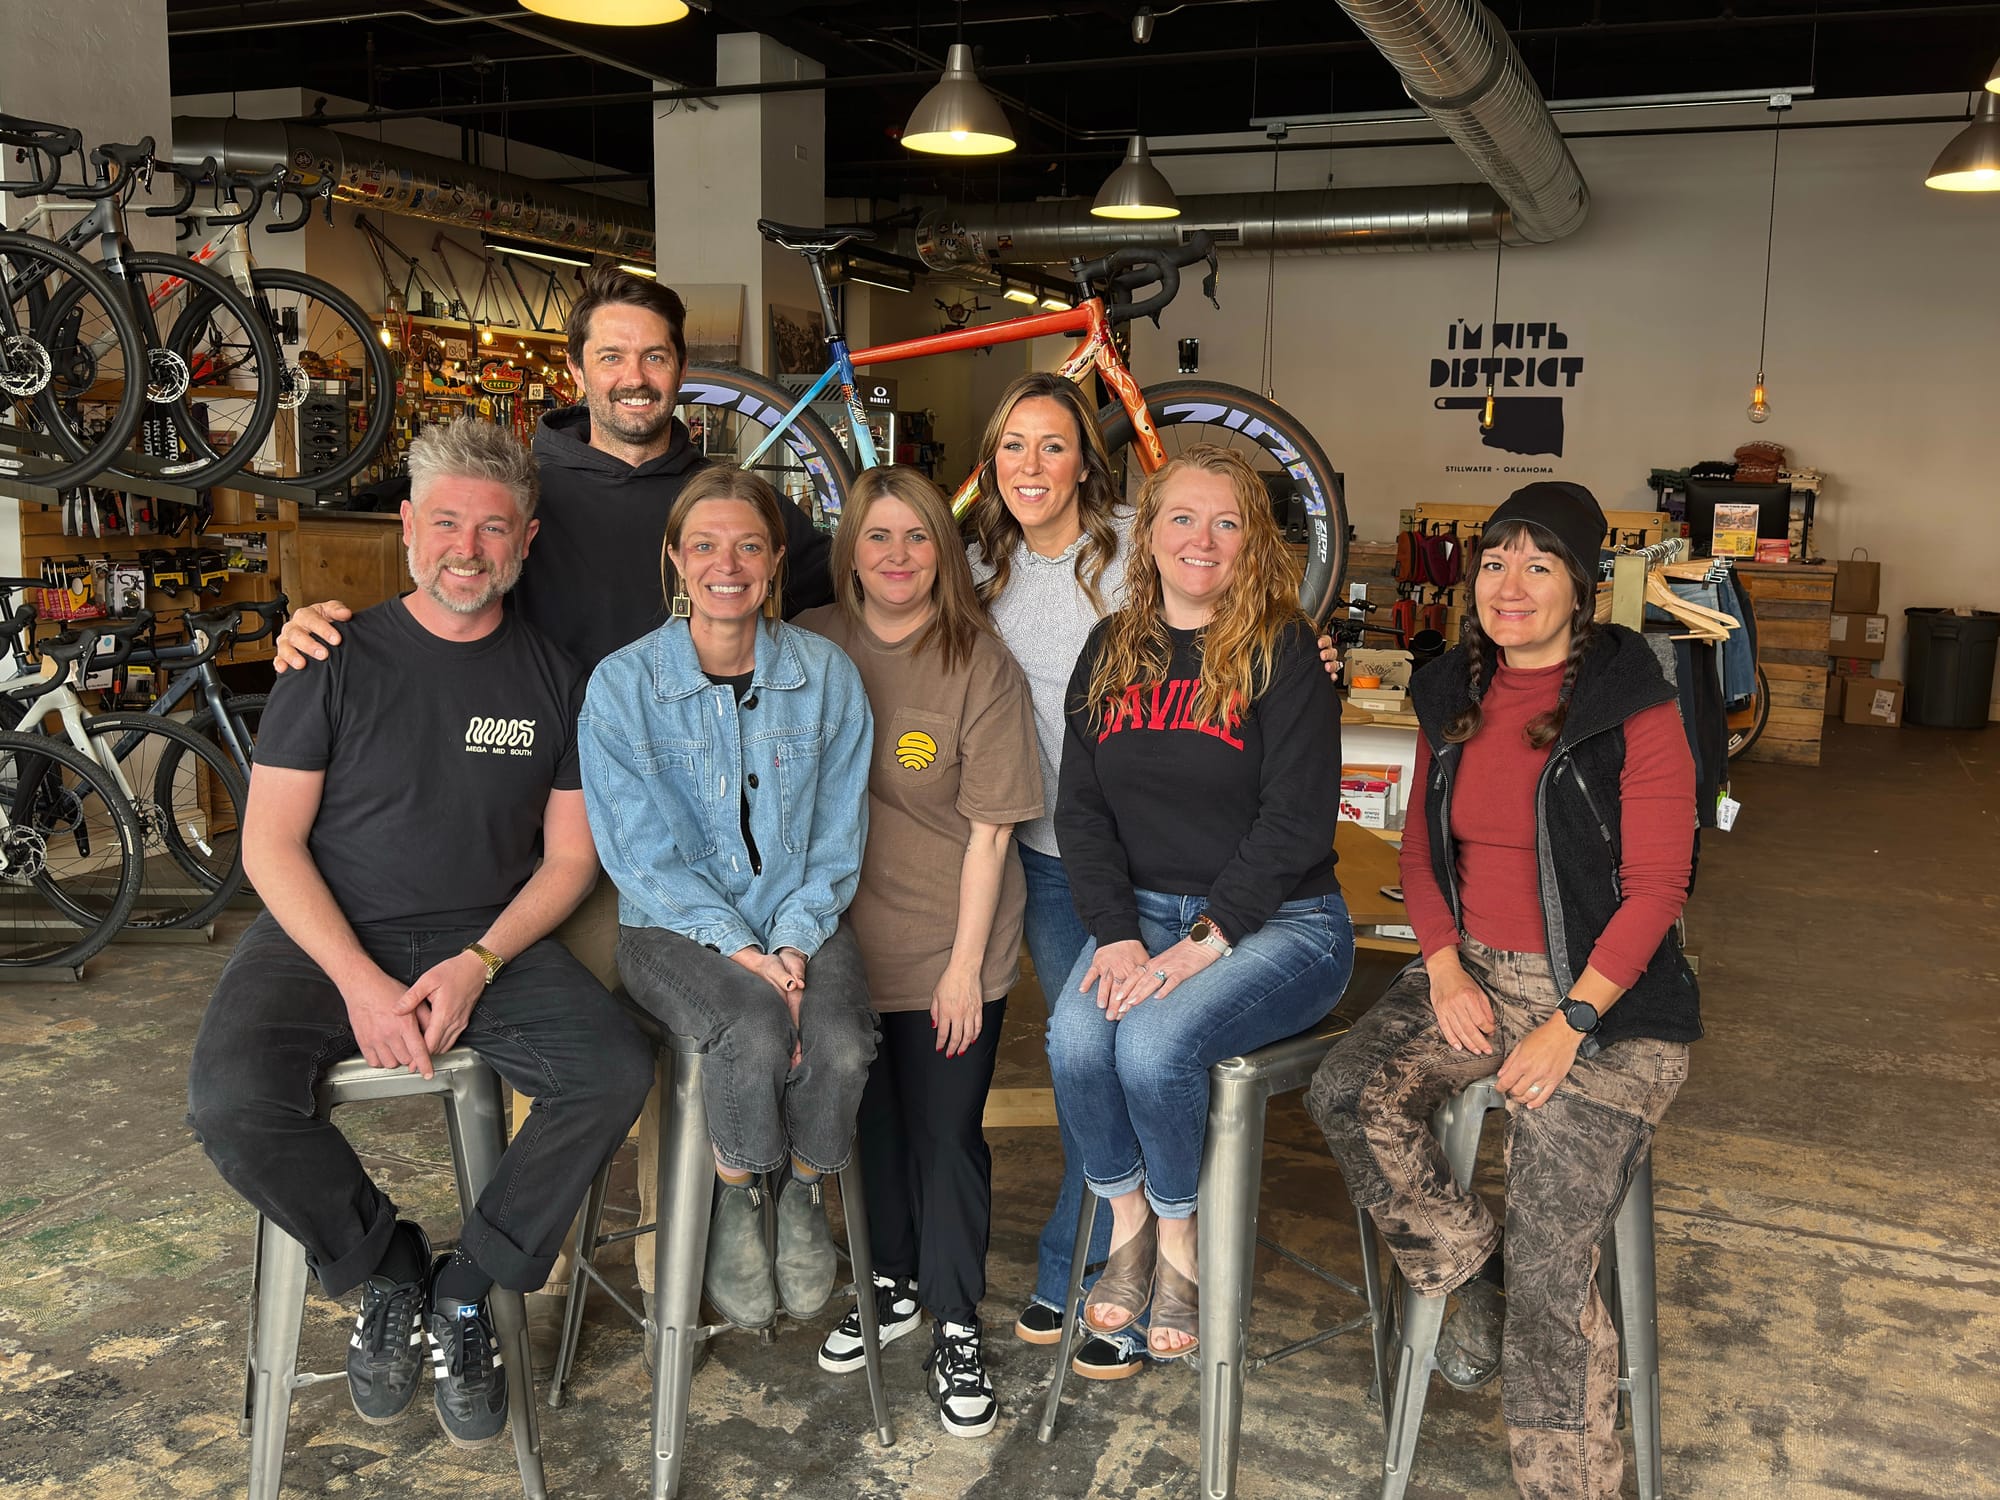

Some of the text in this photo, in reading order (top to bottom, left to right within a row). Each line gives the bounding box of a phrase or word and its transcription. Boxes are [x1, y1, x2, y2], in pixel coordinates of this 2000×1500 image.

[1430, 357, 1584, 388] DISTRICT
[1320, 520, 1328, 564] ZIPP
[492, 747, 506, 755] MID
[510, 748, 532, 757] SOUTH
